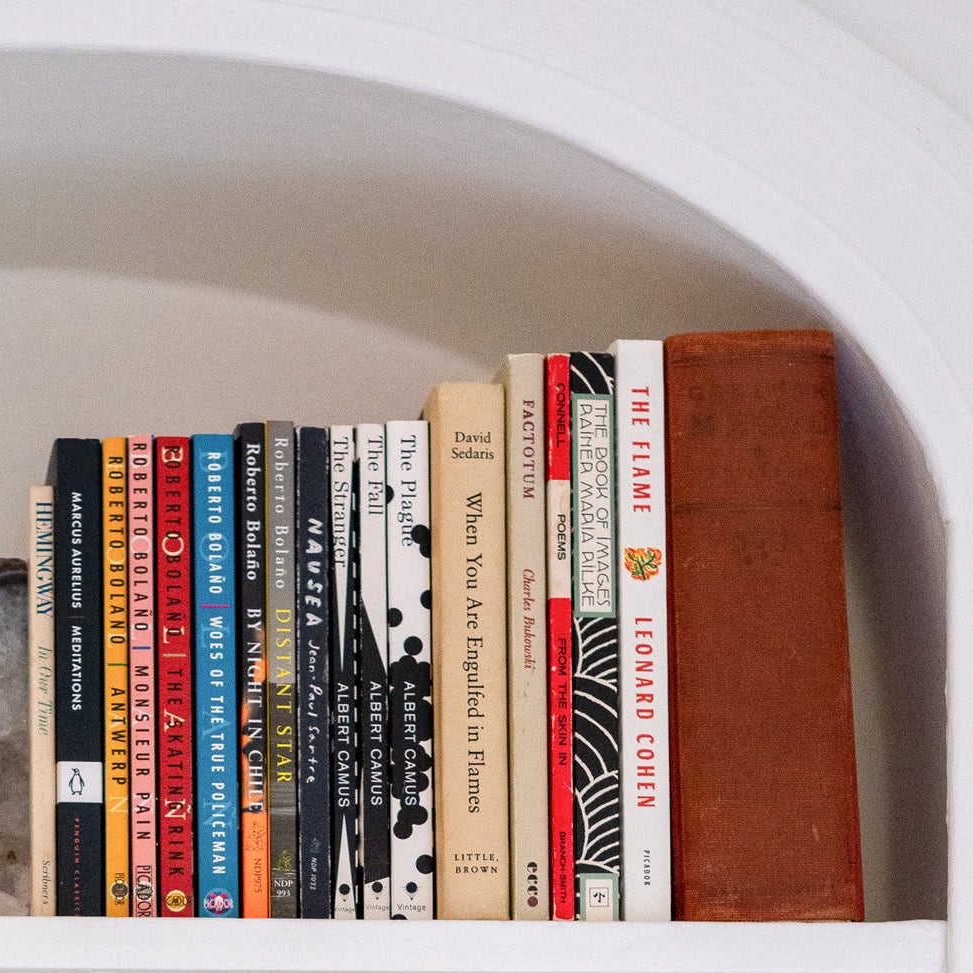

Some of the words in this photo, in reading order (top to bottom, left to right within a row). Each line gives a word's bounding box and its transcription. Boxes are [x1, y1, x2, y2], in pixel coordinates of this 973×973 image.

[556, 383, 566, 448] CONNELL
[594, 404, 608, 438] THE
[631, 386, 650, 427] THE
[333, 436, 349, 473] The
[368, 435, 384, 472] The
[400, 434, 417, 471] The
[452, 447, 495, 460] Sedaris
[455, 431, 491, 444] David
[523, 399, 535, 500] FACTOTUM
[579, 404, 594, 474] RAINER
[133, 443, 149, 536] ROBERTO
[165, 445, 182, 540] ROBERTO
[208, 451, 222, 524] ROBERTO
[246, 443, 262, 512] Roberto
[274, 437, 289, 514] Roberto
[368, 480, 384, 516] Fall
[595, 447, 609, 499] BOOK
[632, 441, 651, 514] FLAME
[71, 491, 82, 545] MARCUS
[109, 456, 124, 549] ROBERTO
[332, 481, 350, 568] Stranger
[397, 479, 418, 547] Plague
[466, 492, 483, 546] When
[579, 481, 595, 544] MARIA
[596, 507, 609, 530] OF
[36, 502, 53, 619] HEMINGWAY
[208, 533, 226, 594] BOLAÑO
[246, 520, 262, 581] Bolaño
[274, 525, 290, 589] Bolaño
[557, 514, 567, 560] POEMS
[71, 548, 82, 609] AURELIUS
[134, 553, 153, 631] BOLAÑO
[305, 518, 324, 627] NAUSEA
[466, 553, 484, 590] You
[523, 569, 535, 612] Charles
[581, 552, 595, 607] RILKE
[596, 537, 612, 607] IMAGES
[209, 616, 223, 660] WOES
[247, 608, 262, 631] BY
[466, 596, 484, 630] Are
[37, 645, 52, 663] In
[71, 625, 82, 711] MEDITATIONS
[276, 608, 293, 714] DISTANT
[523, 616, 536, 669] Bukowski
[558, 637, 567, 676] FROM
[634, 617, 654, 720] LEONARD
[37, 666, 53, 696] Our
[166, 670, 183, 705] THE
[210, 669, 224, 687] OF
[247, 641, 263, 708] NIGHT
[307, 640, 323, 717] Jean-Paul
[463, 636, 486, 719] Engulfed
[558, 684, 568, 709] THE
[37, 700, 53, 736] Time
[111, 687, 127, 785] ANTWERP
[135, 666, 151, 776] MONSIEUR
[210, 695, 224, 724] THE
[248, 718, 263, 739] IN
[337, 682, 350, 744] ALBERT
[370, 680, 383, 742] ALBERT
[403, 680, 417, 742] ALBERT
[467, 725, 484, 743] in
[559, 715, 568, 746] SKIN
[167, 720, 184, 810] SKATING
[210, 733, 225, 772] TRUE
[248, 750, 264, 812] CHILE
[277, 725, 293, 783] STAR
[306, 725, 321, 784] Sartre
[337, 750, 350, 807] CAMUS
[370, 748, 383, 806] CAMUS
[404, 748, 417, 806] CAMUS
[559, 752, 568, 766] IN
[636, 734, 655, 808] COHEN
[467, 749, 485, 814] Flames
[136, 792, 151, 840] PAIN
[211, 782, 226, 874] POLICEMAN
[168, 826, 184, 876] RINK
[254, 857, 262, 893] NDP975
[454, 853, 499, 863] LITTLE,
[455, 866, 498, 874] BROWN
[559, 831, 567, 904] BRANCH-SMITH
[643, 850, 651, 886] PICADOR
[136, 865, 152, 917] PICADOR
[397, 903, 427, 912] Vintage
